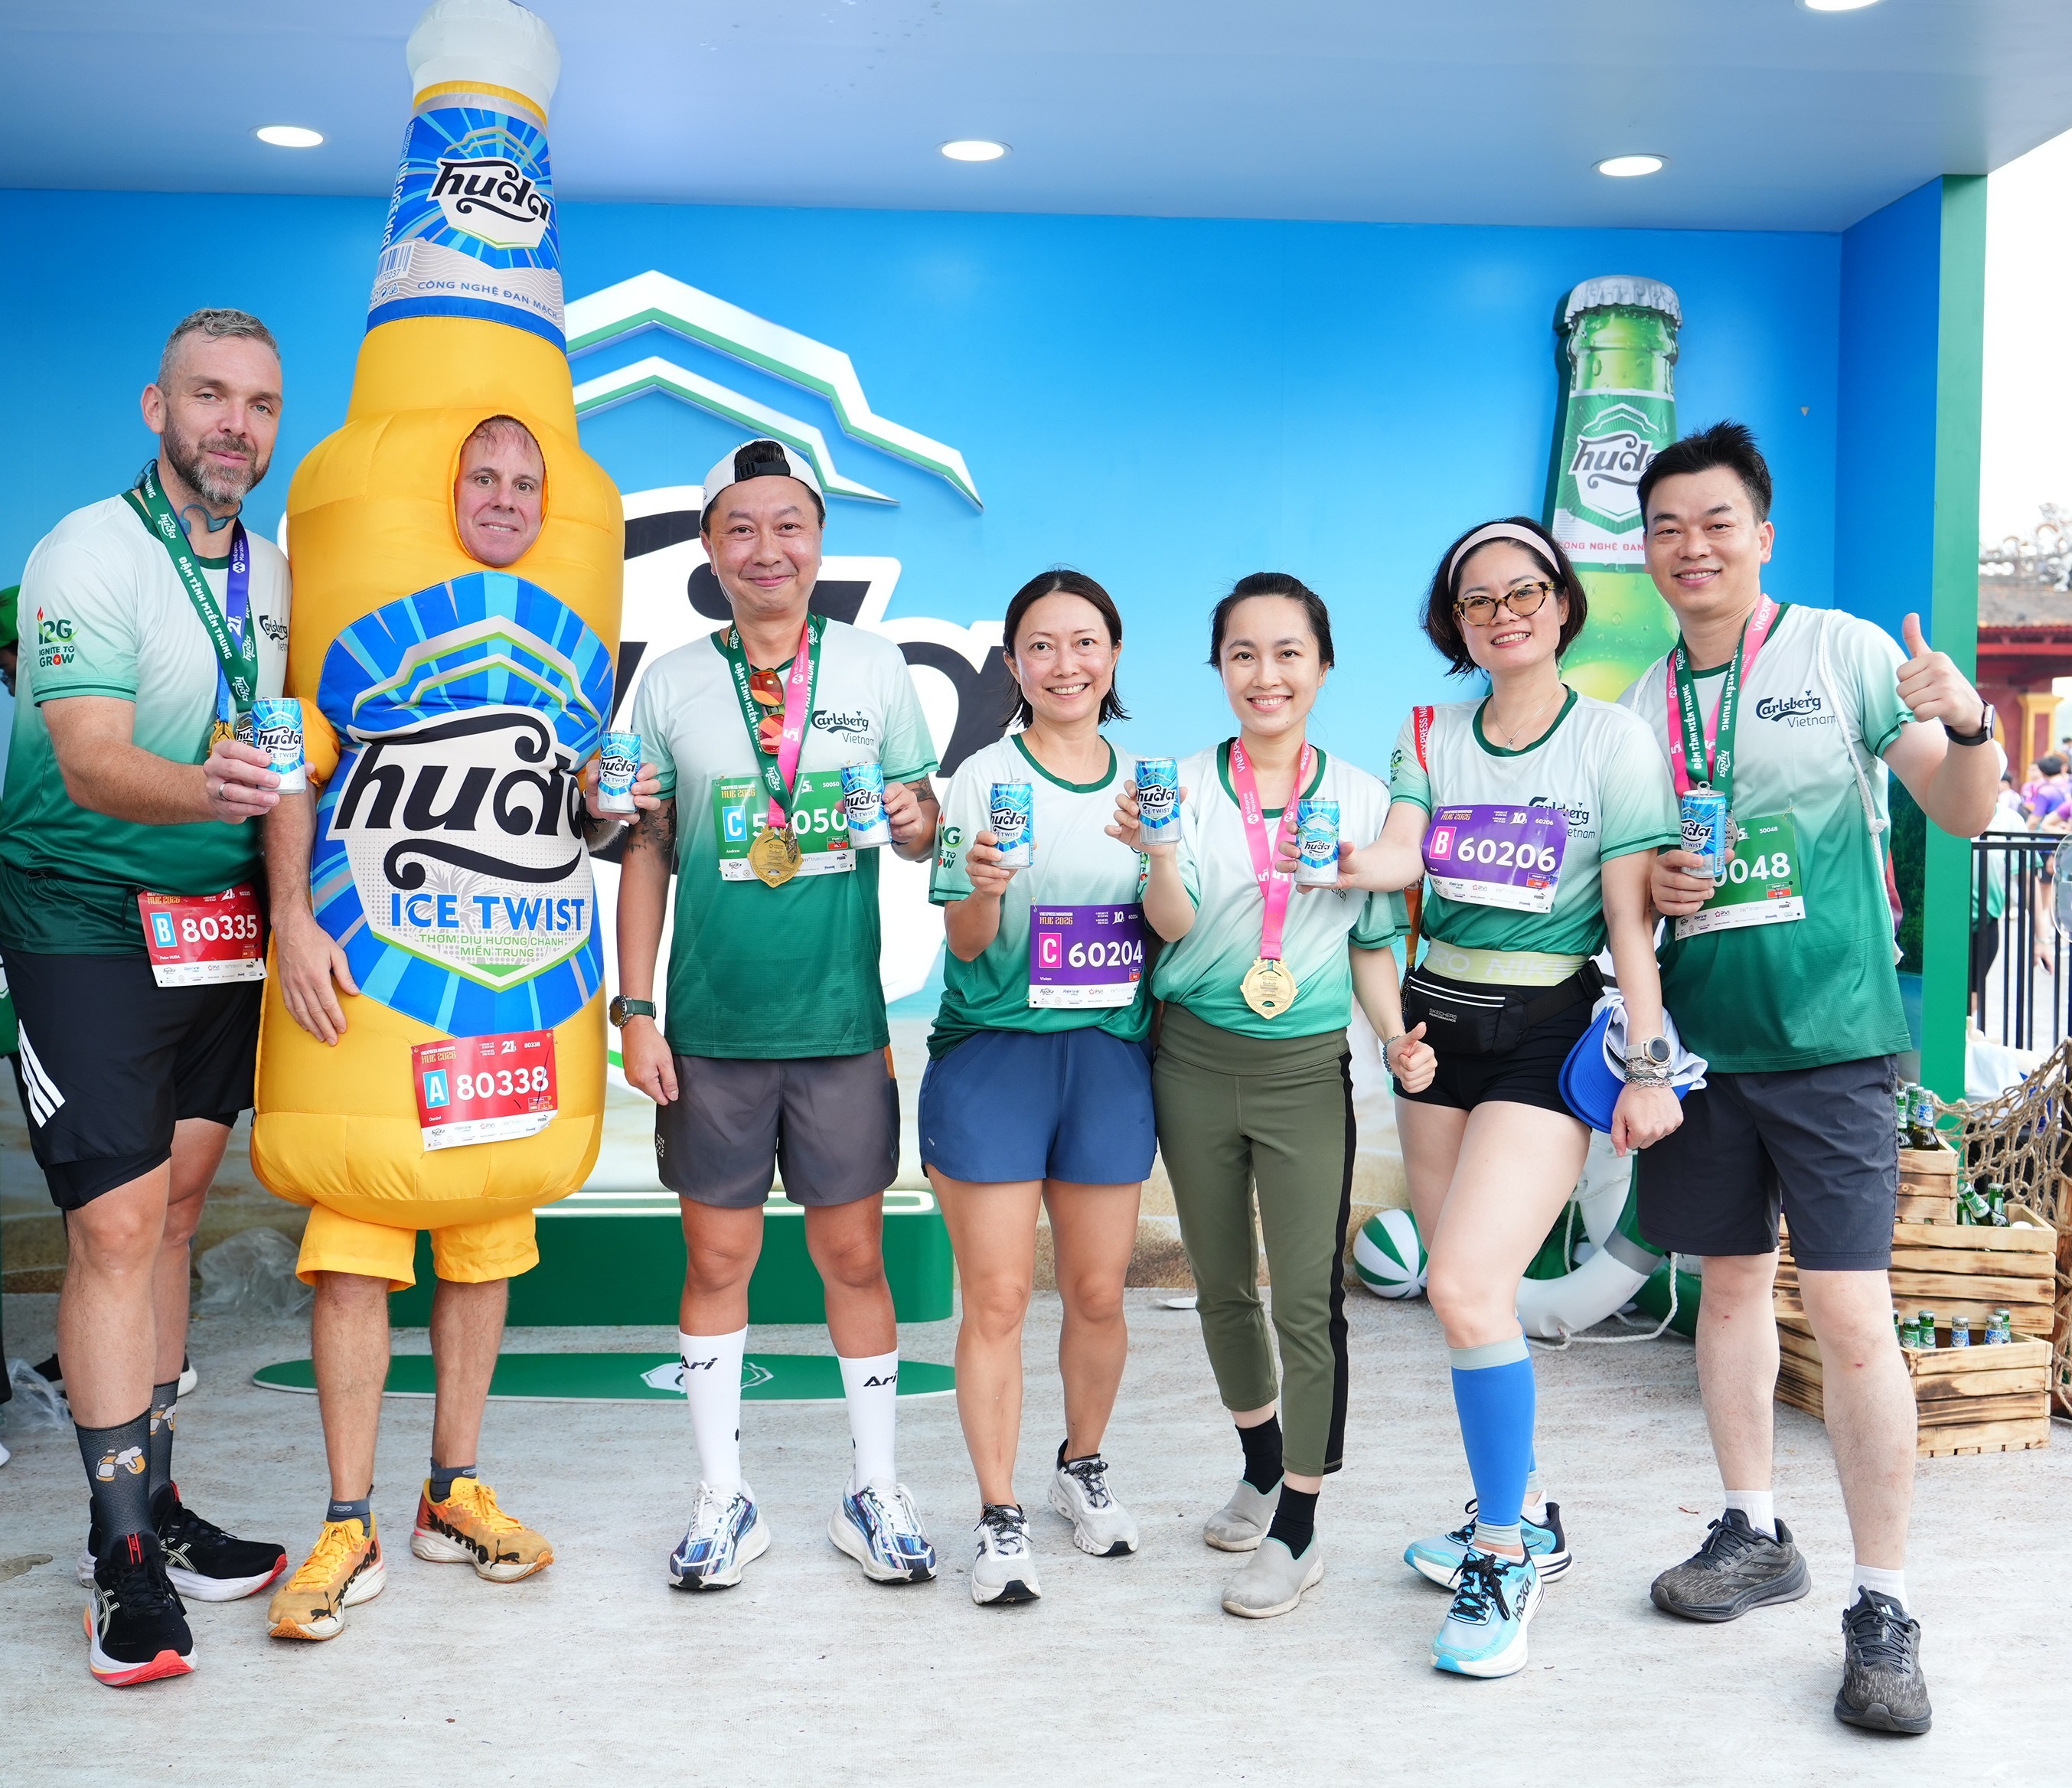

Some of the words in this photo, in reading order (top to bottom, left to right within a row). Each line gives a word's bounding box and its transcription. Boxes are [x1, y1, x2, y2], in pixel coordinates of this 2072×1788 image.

[389, 185, 403, 214] 330
[432, 160, 550, 223] huda
[418, 280, 455, 290] CÔNG
[461, 283, 498, 296] NGHỆ
[504, 289, 530, 305] ĐAN
[533, 300, 558, 320] MẠCH
[1590, 542, 1618, 551] NGHỆ
[39, 646, 60, 657] IGNITE
[214, 626, 233, 660] TRUNG
[39, 654, 75, 667] GROW
[1682, 684, 1694, 712] TRUNG
[1756, 697, 1822, 723] Carlsberg
[811, 710, 870, 733] Carlsberg
[1721, 698, 1732, 732] TRUNG
[1786, 714, 1837, 729] Vietnam
[257, 726, 303, 753] huda
[842, 732, 875, 747] Vietnam
[600, 755, 636, 777] huda
[845, 788, 880, 814] huda
[1137, 785, 1176, 809] huda
[727, 811, 742, 837] C
[752, 808, 848, 837] 5050
[990, 808, 1026, 832] huda
[1759, 826, 1778, 834] 50048
[1304, 840, 1330, 854] huda
[1434, 830, 1450, 855] B
[1457, 837, 1557, 873] 60206
[390, 892, 459, 928] ICE
[472, 896, 585, 932] TWIST
[155, 917, 171, 944] B
[181, 914, 258, 944] 80335
[419, 933, 457, 945] THƠM
[460, 935, 482, 946] DỊU
[485, 935, 527, 946] HƯƠNG
[530, 936, 564, 947] CHANH
[496, 948, 534, 958] TRUNG
[1043, 938, 1057, 964] C
[1069, 939, 1144, 968] 60204
[1428, 1007, 1457, 1019] SKECHERS
[1428, 1012, 1457, 1023] PERFORMANCE
[429, 1075, 445, 1103] A
[456, 1065, 550, 1101] 80338
[680, 1355, 719, 1370] Ari
[863, 1370, 899, 1387] Ari
[1512, 1577, 1532, 1623] HOKA
